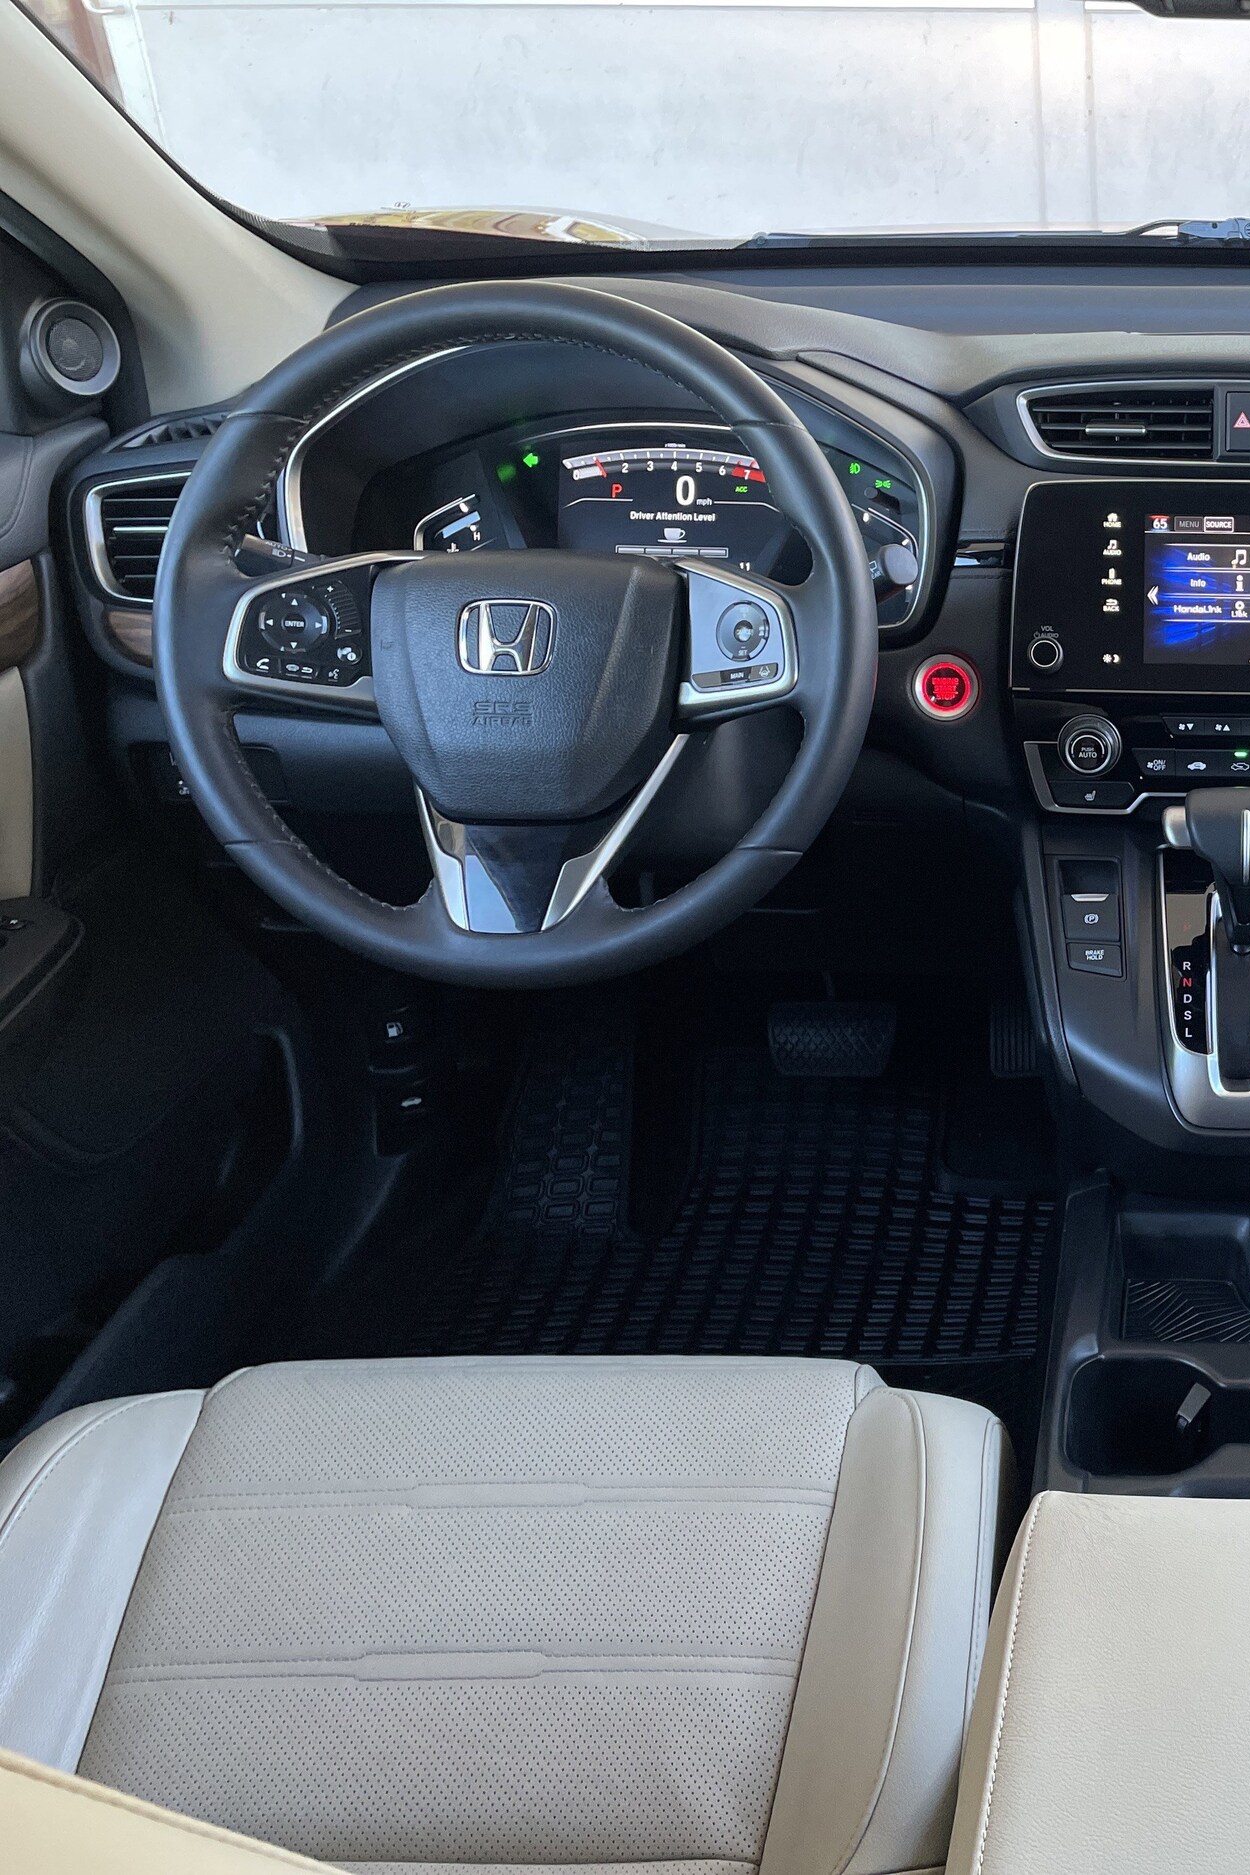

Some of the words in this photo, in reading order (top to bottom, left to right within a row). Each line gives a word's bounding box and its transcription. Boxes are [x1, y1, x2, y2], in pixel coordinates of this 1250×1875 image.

[622, 462, 629, 473] 2
[647, 461, 654, 471] 3
[670, 461, 678, 471] 4
[696, 462, 702, 472] 5
[718, 464, 726, 476] 6
[744, 470, 750, 480] 7
[612, 484, 622, 498] P
[676, 476, 695, 506] 0
[696, 498, 712, 506] mph
[630, 510, 654, 520] Driver
[656, 512, 692, 520] Attention
[694, 513, 716, 521] Level
[1153, 518, 1168, 529] 65
[474, 532, 480, 541] H
[1187, 552, 1210, 561] Audio
[1190, 578, 1206, 588] Info
[1173, 604, 1222, 614] HondaLink
[474, 702, 532, 714] SRS
[1182, 962, 1191, 971] R
[1182, 978, 1192, 987] N
[1183, 994, 1192, 1004] D
[1184, 1011, 1192, 1020] S
[1185, 1028, 1192, 1038] L
